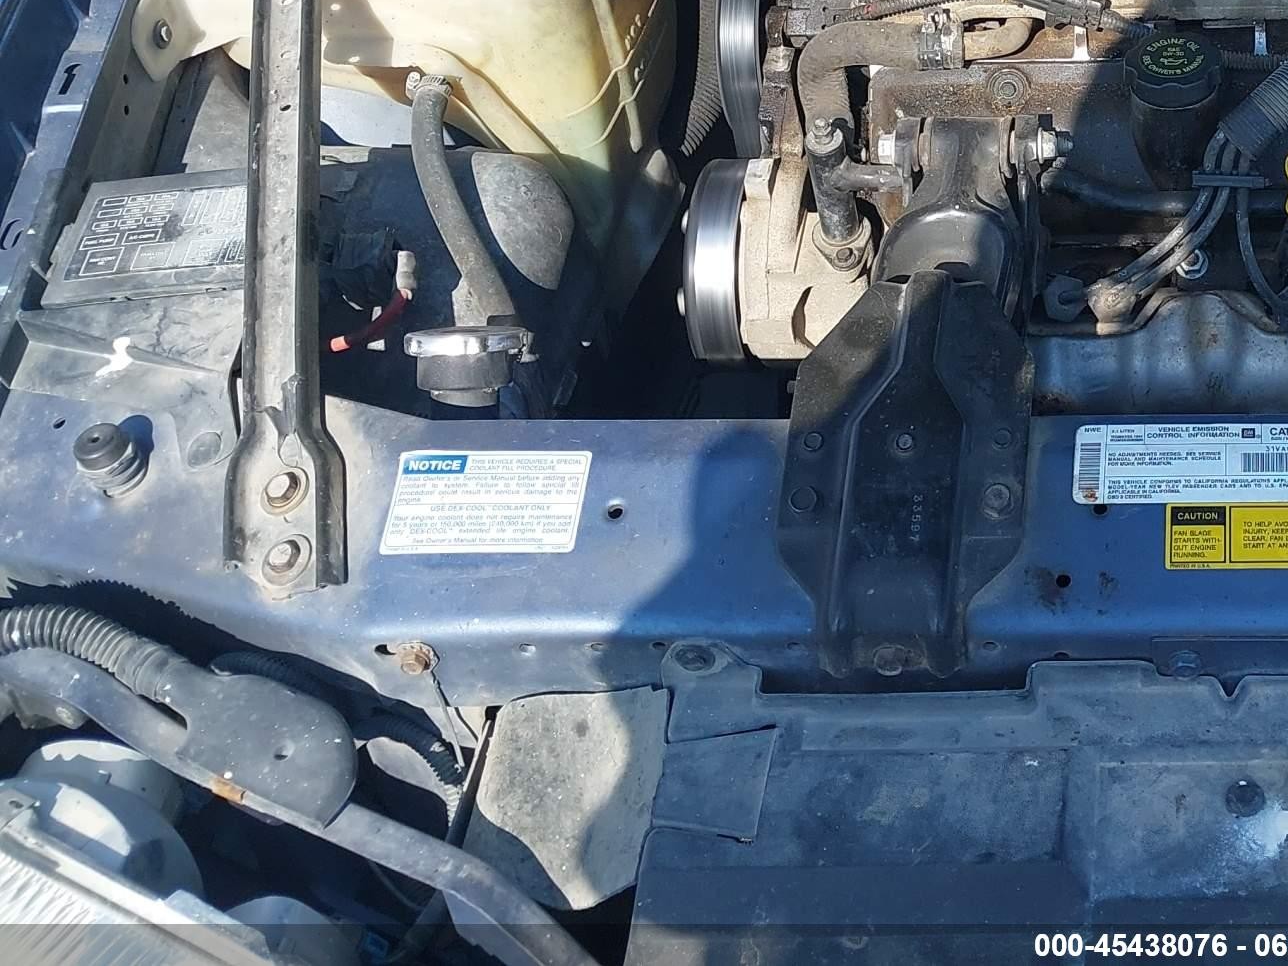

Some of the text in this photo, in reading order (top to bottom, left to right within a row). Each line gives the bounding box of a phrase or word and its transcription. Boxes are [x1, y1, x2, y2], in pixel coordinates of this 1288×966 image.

[1146, 38, 1200, 52] ENGINE OIL
[1158, 425, 1229, 433] VEHICLE EMISSION
[408, 459, 462, 471] NOTICE
[1177, 512, 1218, 520] CAUTION
